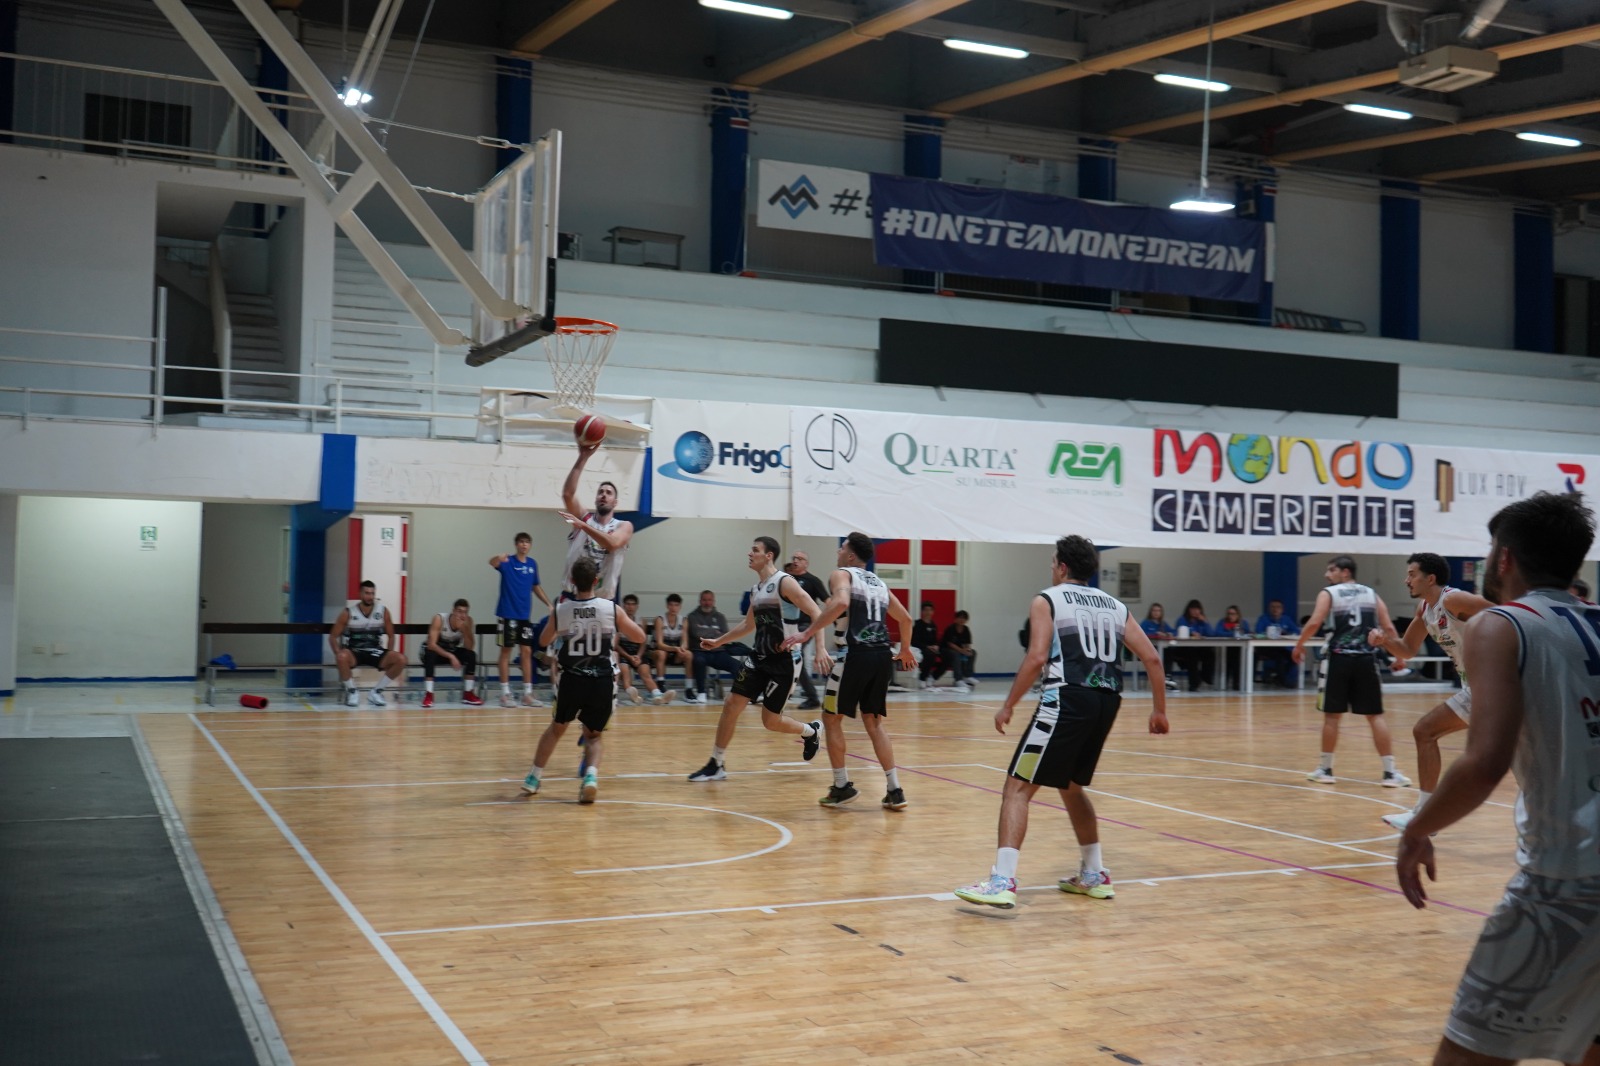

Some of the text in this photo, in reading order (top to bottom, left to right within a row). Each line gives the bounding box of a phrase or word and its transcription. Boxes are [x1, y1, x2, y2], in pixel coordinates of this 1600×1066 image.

[881, 206, 1256, 274] #ONETEAMONEDREAM
[1047, 440, 1122, 487] REA
[1153, 491, 1414, 537] CAMERETTE
[1062, 591, 1117, 611] D'ANTONIO
[567, 620, 603, 657] 20
[1075, 608, 1118, 663] 00
